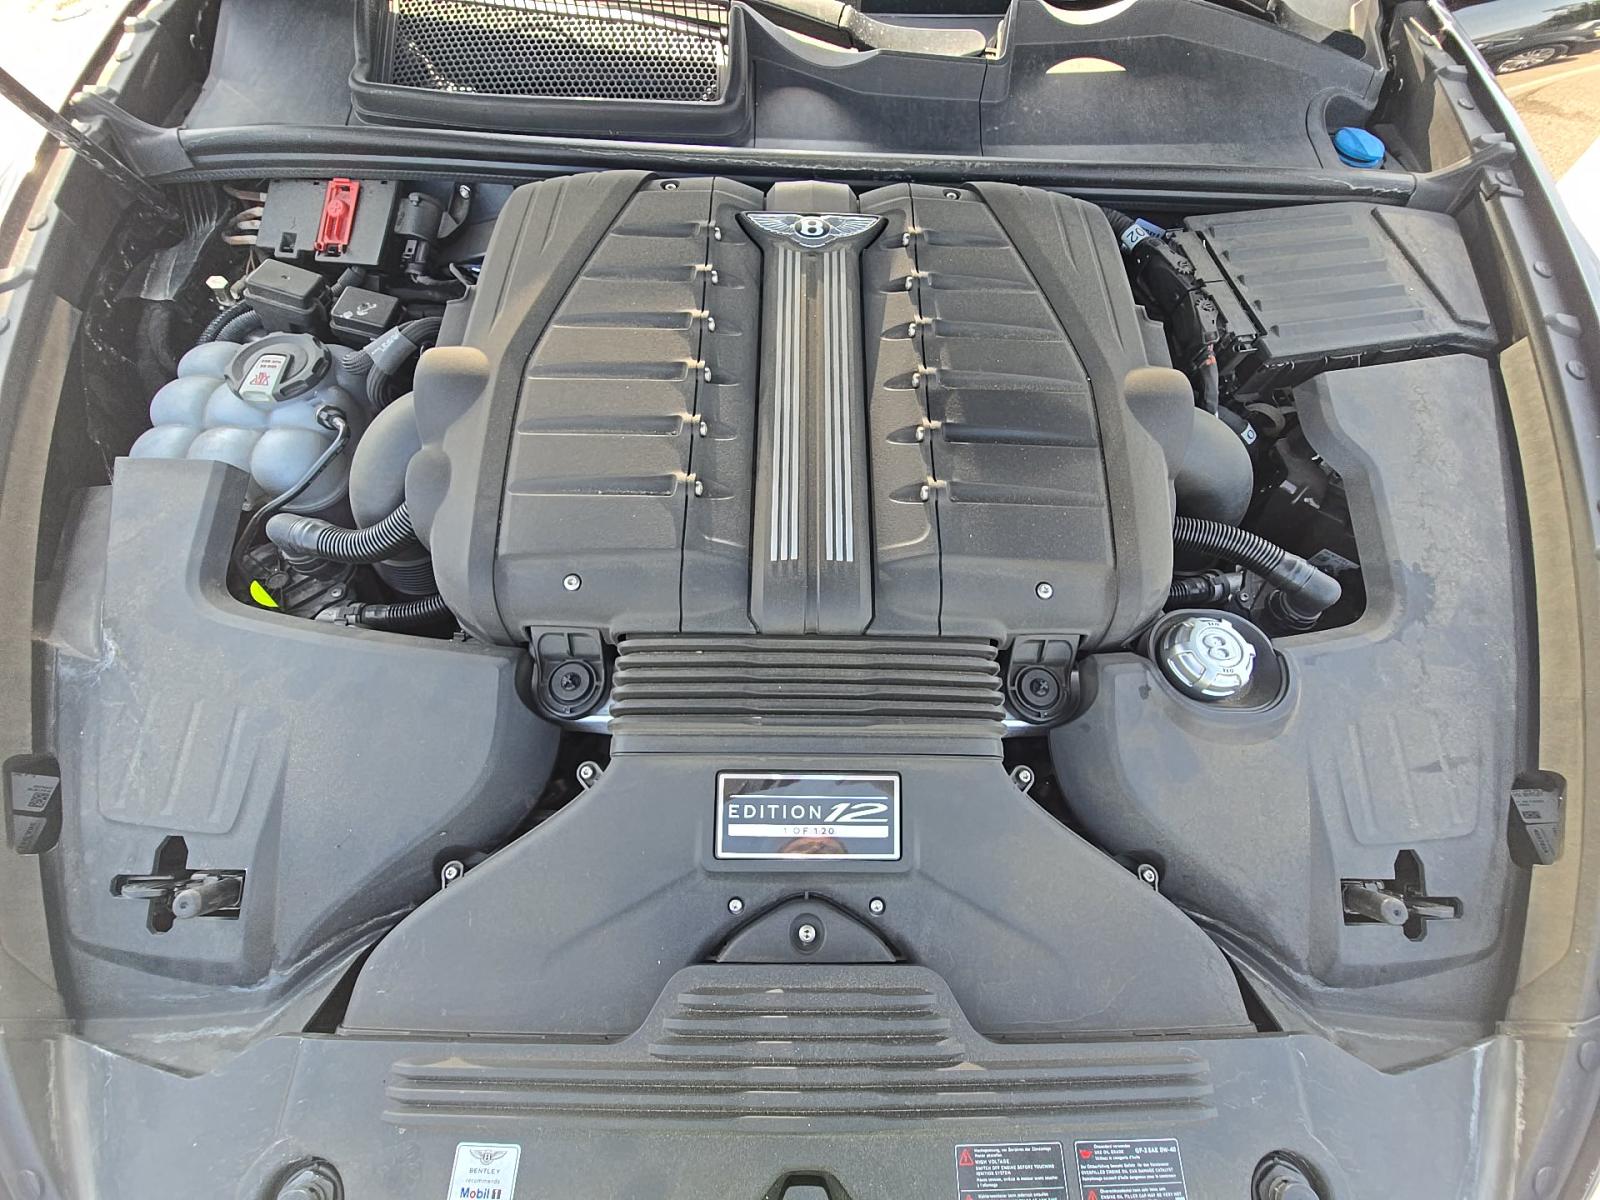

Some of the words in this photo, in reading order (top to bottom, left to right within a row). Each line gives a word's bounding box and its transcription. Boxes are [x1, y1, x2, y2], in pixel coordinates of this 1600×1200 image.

[728, 804, 821, 820] EDITION
[823, 802, 888, 822] 12
[793, 827, 808, 835] OF
[814, 827, 835, 835] 120
[460, 1187, 490, 1199] Mobil
